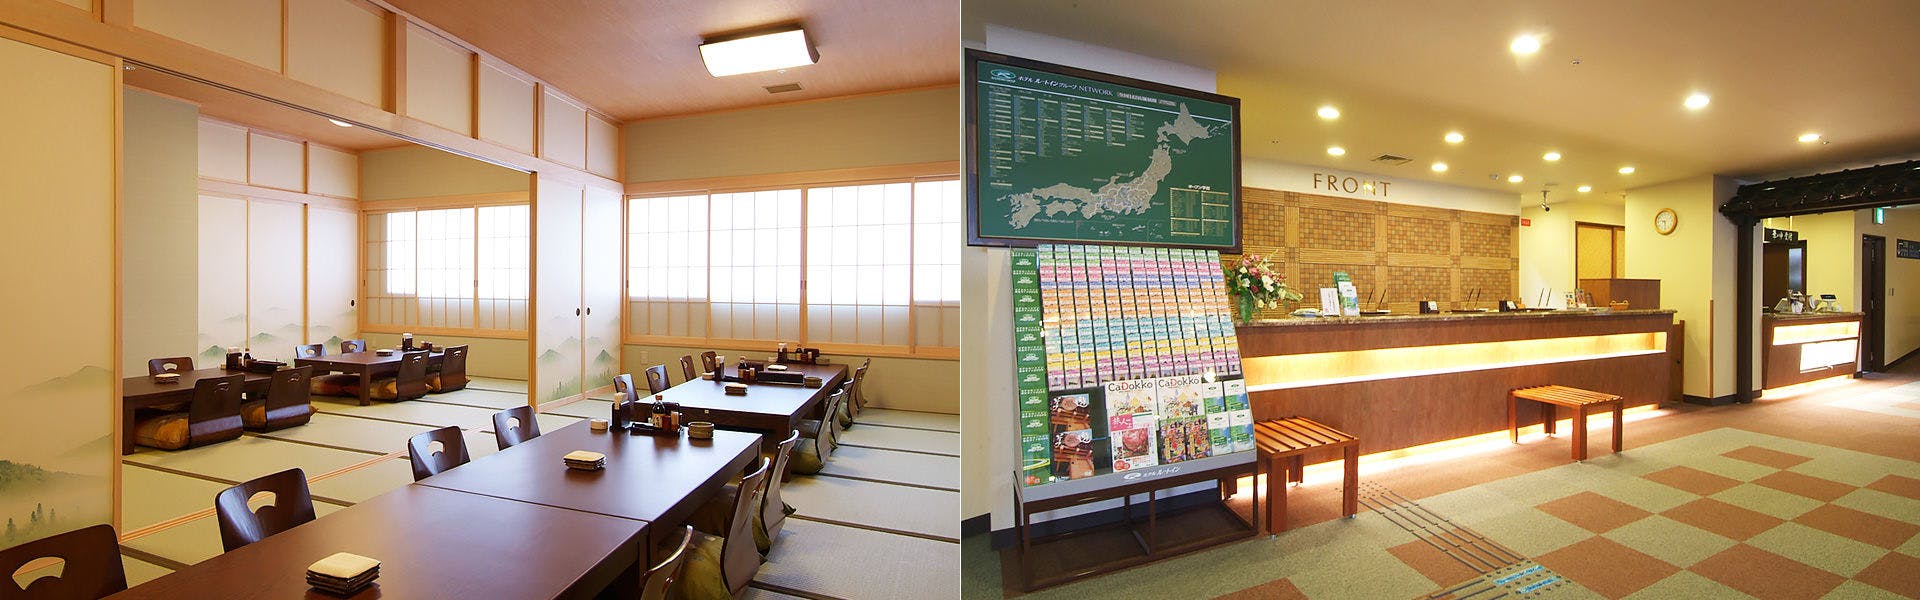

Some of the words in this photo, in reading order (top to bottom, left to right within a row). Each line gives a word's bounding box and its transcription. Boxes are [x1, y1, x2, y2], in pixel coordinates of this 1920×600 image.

[1079, 84, 1113, 96] NETWORK
[1313, 172, 1391, 197] FRONT
[1108, 380, 1153, 392] CaDokko
[1158, 376, 1200, 388] CaDokko
